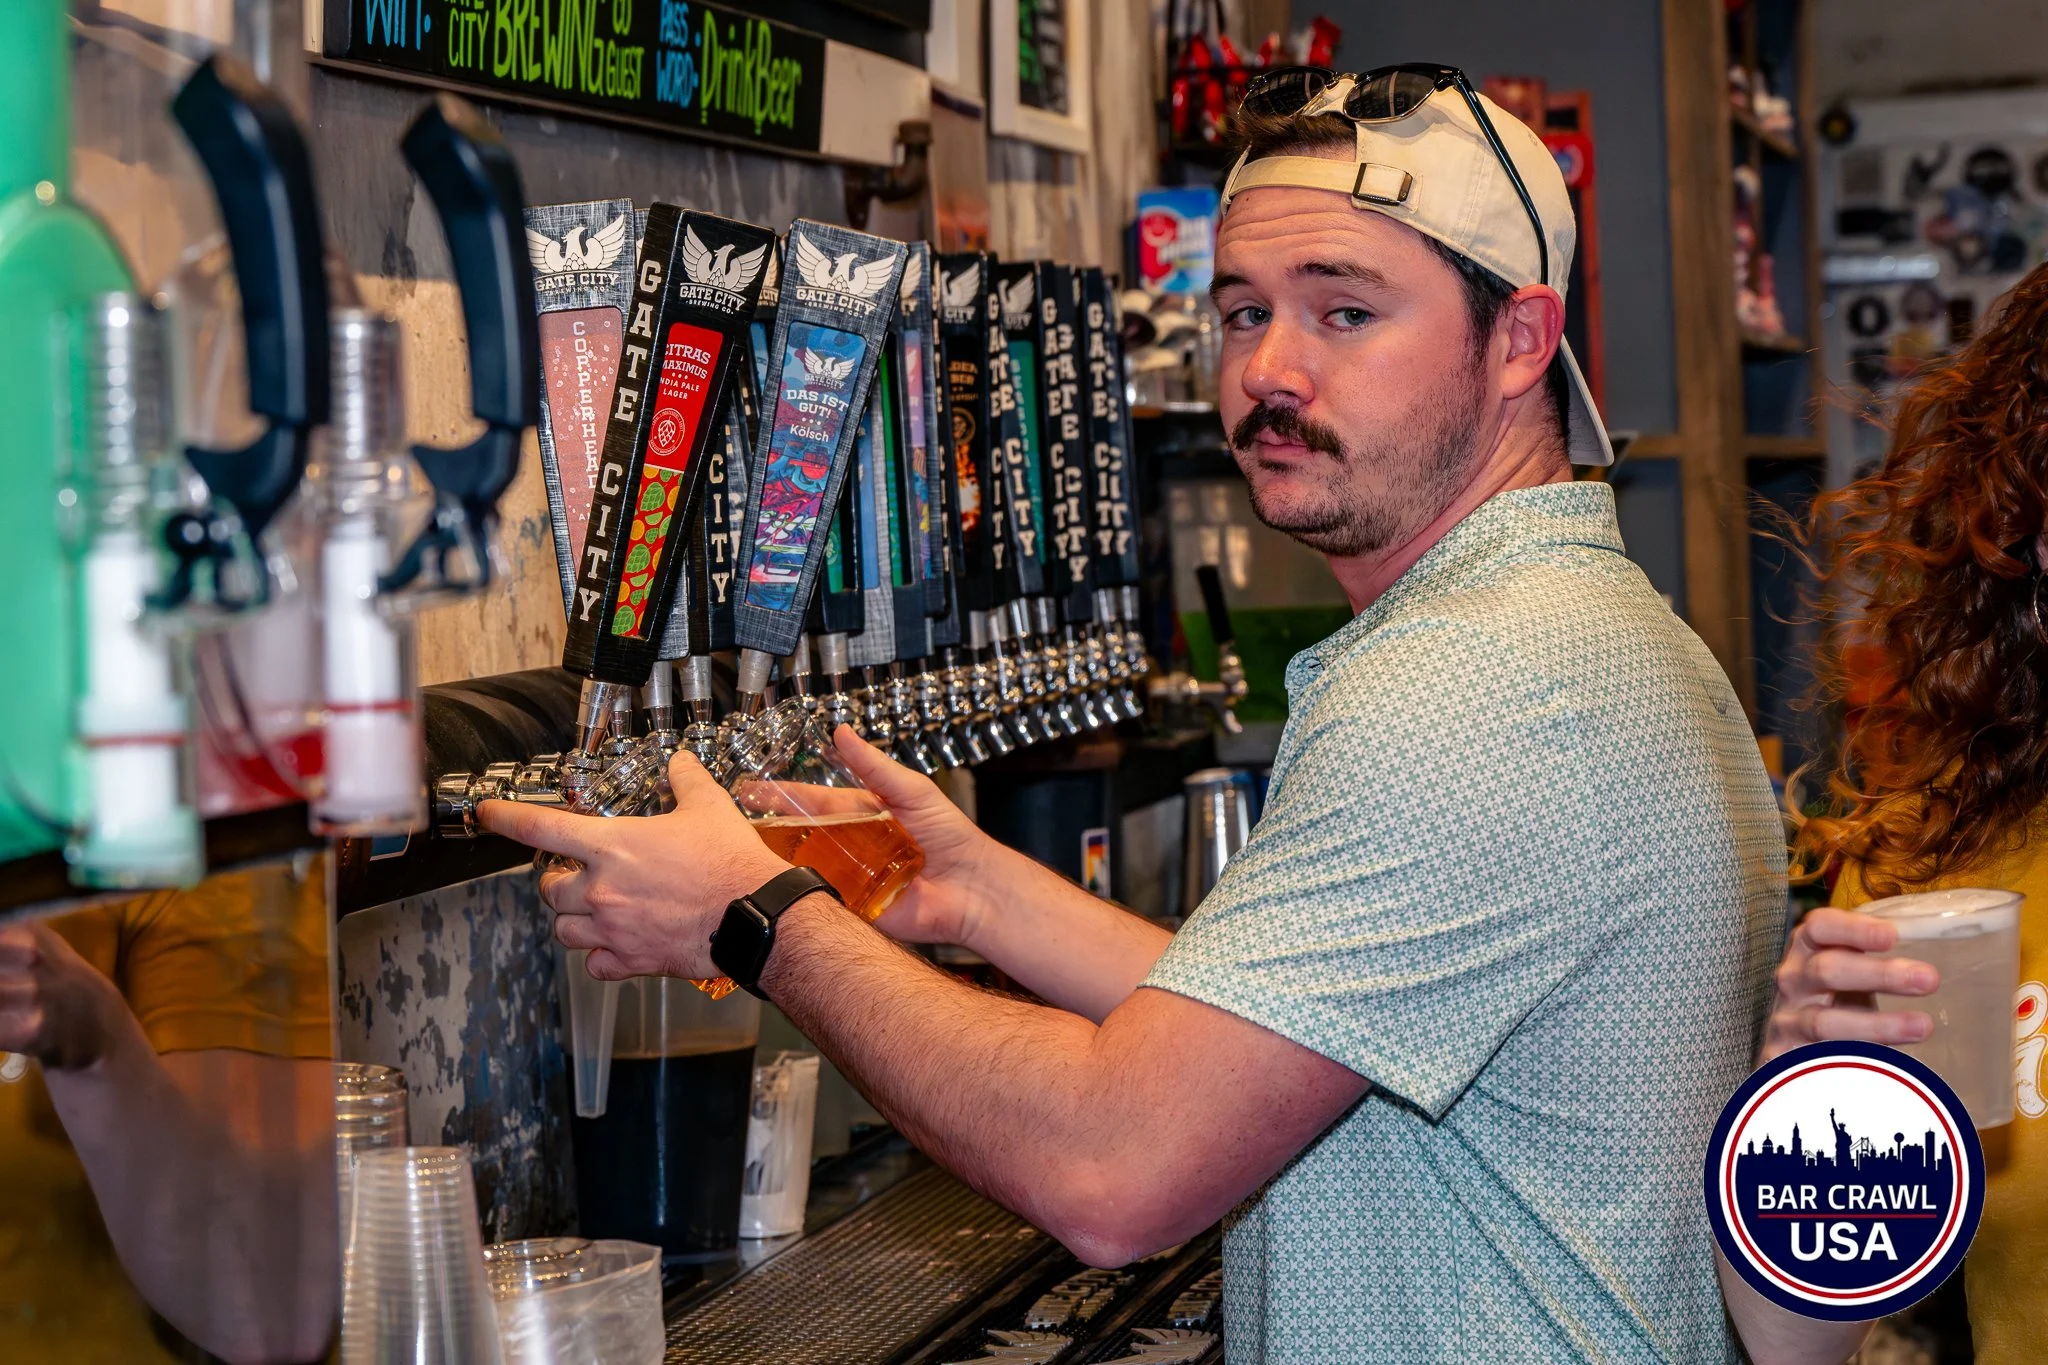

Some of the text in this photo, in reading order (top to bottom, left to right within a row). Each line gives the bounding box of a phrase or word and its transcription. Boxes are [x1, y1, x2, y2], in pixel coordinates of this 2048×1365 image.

[449, 0, 605, 97] CITY BREWING
[605, 39, 645, 99] GUEST
[535, 273, 619, 292] GATE CITY
[680, 286, 713, 302] GATE
[715, 289, 746, 312] CITY
[796, 289, 877, 316] GATE CITY
[660, 376, 700, 392] NDIA PALE
[1087, 302, 1108, 418] GATE
[662, 388, 688, 400] LAGER
[786, 389, 849, 412] DAS IST
[799, 402, 832, 418] GUT!
[579, 260, 662, 622] GATE CITY
[789, 424, 829, 443] Kölsch
[1042, 297, 1068, 560] GATE CITY
[1005, 437, 1036, 557] CITY
[1064, 466, 1089, 582] CITY
[1094, 441, 1114, 556] CITY
[709, 453, 729, 602] CITY
